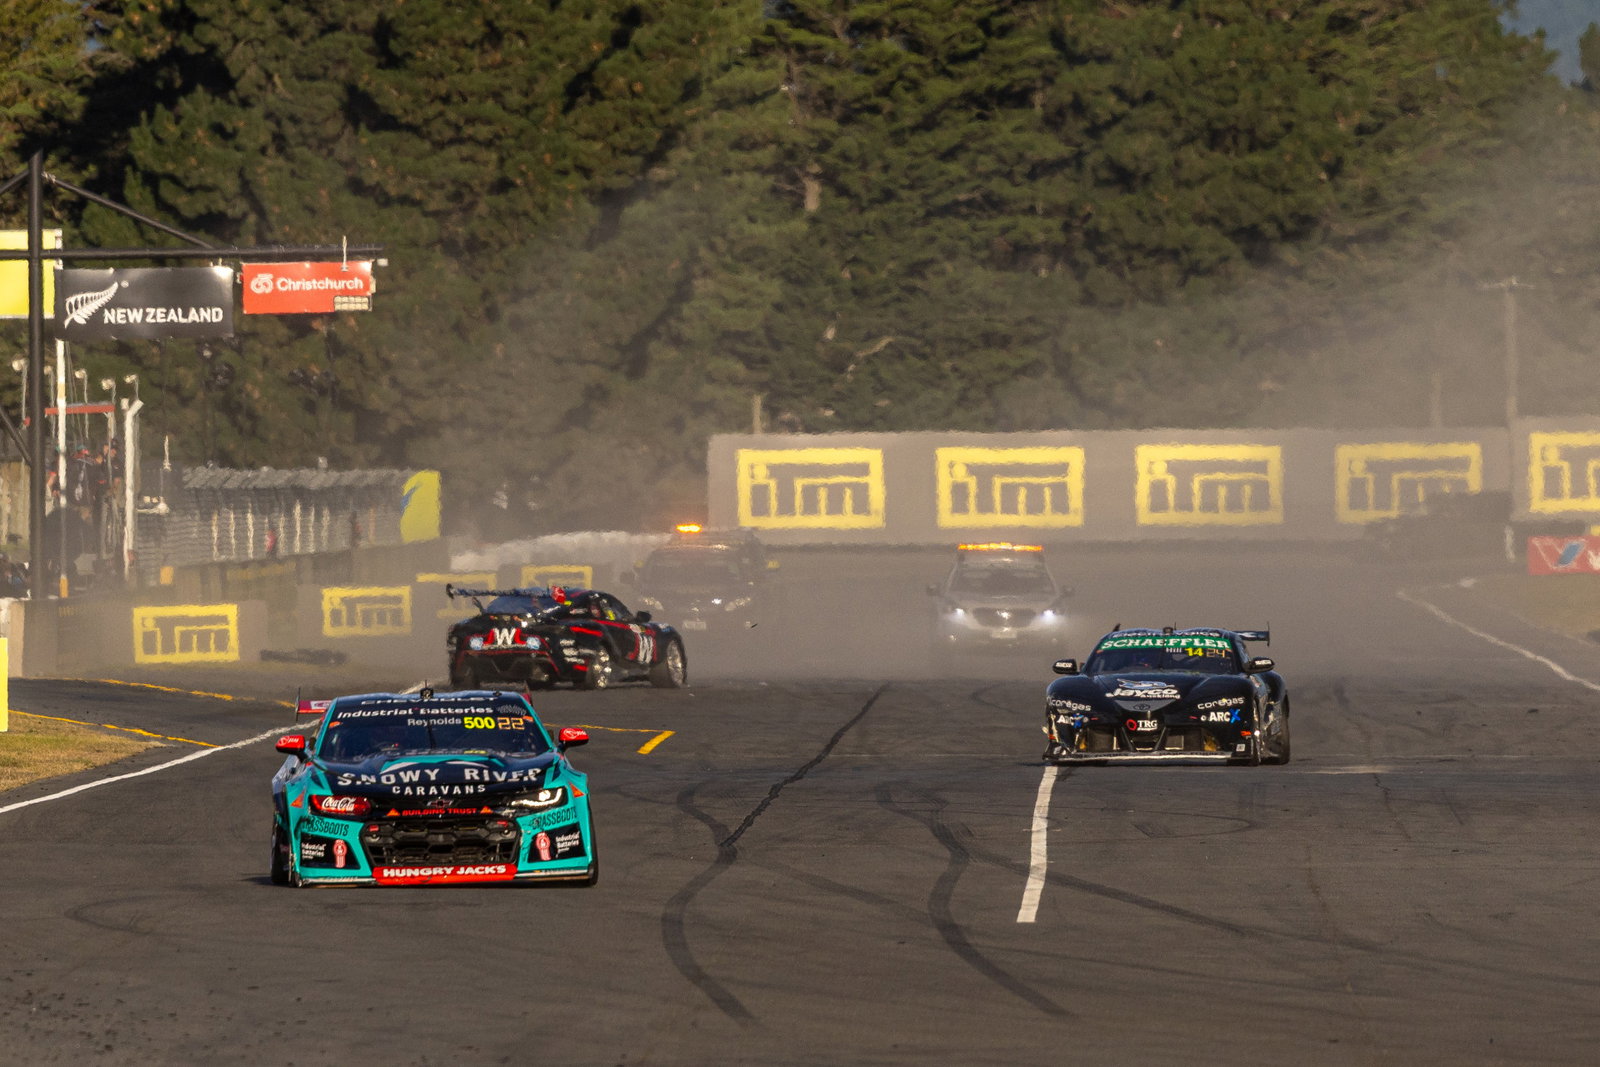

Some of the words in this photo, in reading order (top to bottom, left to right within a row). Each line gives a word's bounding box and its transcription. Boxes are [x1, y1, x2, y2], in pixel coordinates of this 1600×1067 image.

[276, 277, 364, 292] Christchurch
[103, 307, 144, 325] NEW
[144, 306, 224, 325] ZEALAND
[1101, 637, 1231, 650] SCHAEFFLER
[1184, 647, 1204, 657] 14
[1205, 648, 1226, 658] 24
[1105, 687, 1179, 698] Jayco
[337, 707, 413, 719] Industrial
[419, 705, 494, 716] Batteries
[407, 717, 462, 728] Reynolds
[463, 716, 496, 730] 500
[496, 716, 526, 730] 22
[1137, 719, 1158, 728] TRG
[337, 768, 440, 787] SNOWY
[463, 767, 543, 783] RIVER
[392, 784, 487, 796] CARAVANS
[446, 806, 478, 815] TRUST
[383, 867, 455, 878] HUNGRY
[456, 865, 507, 875] JACK'S
